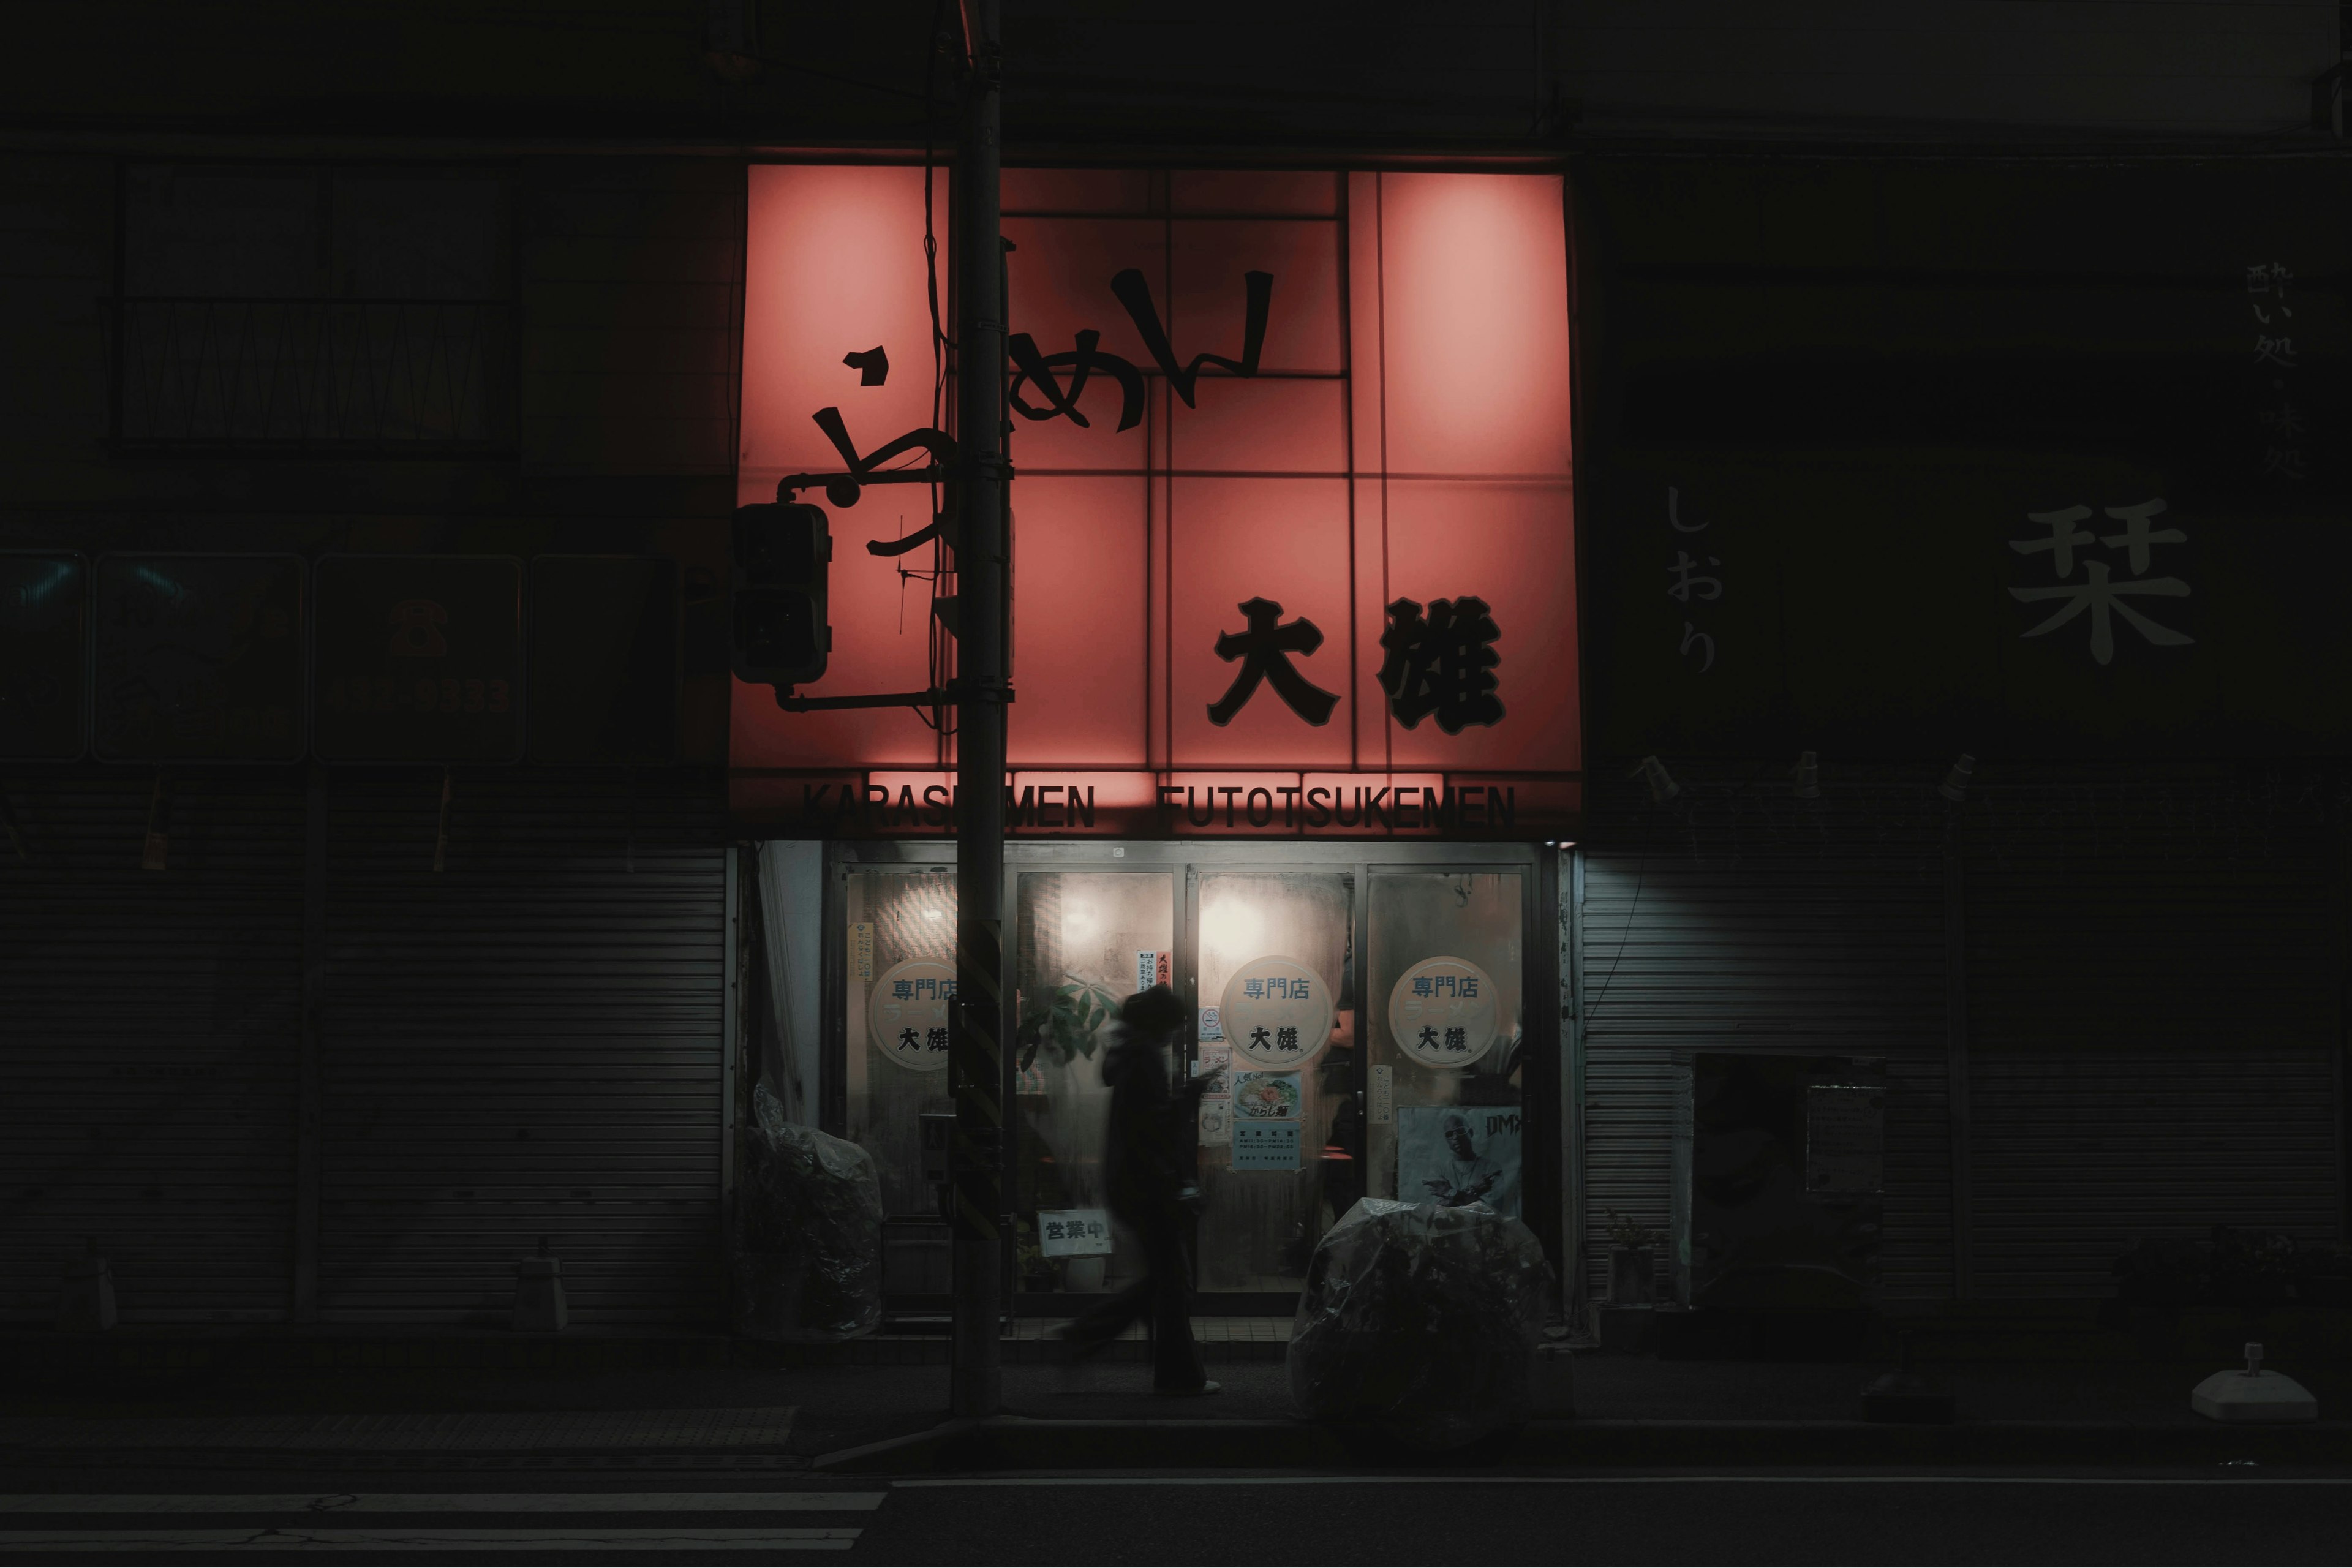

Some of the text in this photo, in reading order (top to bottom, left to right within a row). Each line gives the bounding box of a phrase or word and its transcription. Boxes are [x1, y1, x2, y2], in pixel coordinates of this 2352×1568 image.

[1667, 486, 1723, 674] しおり
[2007, 497, 2196, 666] 栞
[1207, 596, 1507, 736] 大雄
[1158, 786, 1515, 829] FUTOTSUKEMEN
[1243, 978, 1310, 1000] 専門店
[1412, 976, 1479, 998] 専門店
[1250, 1025, 1299, 1052] 大雄
[1417, 1025, 1468, 1052] 大雄
[1046, 1219, 1105, 1240] 営業中
